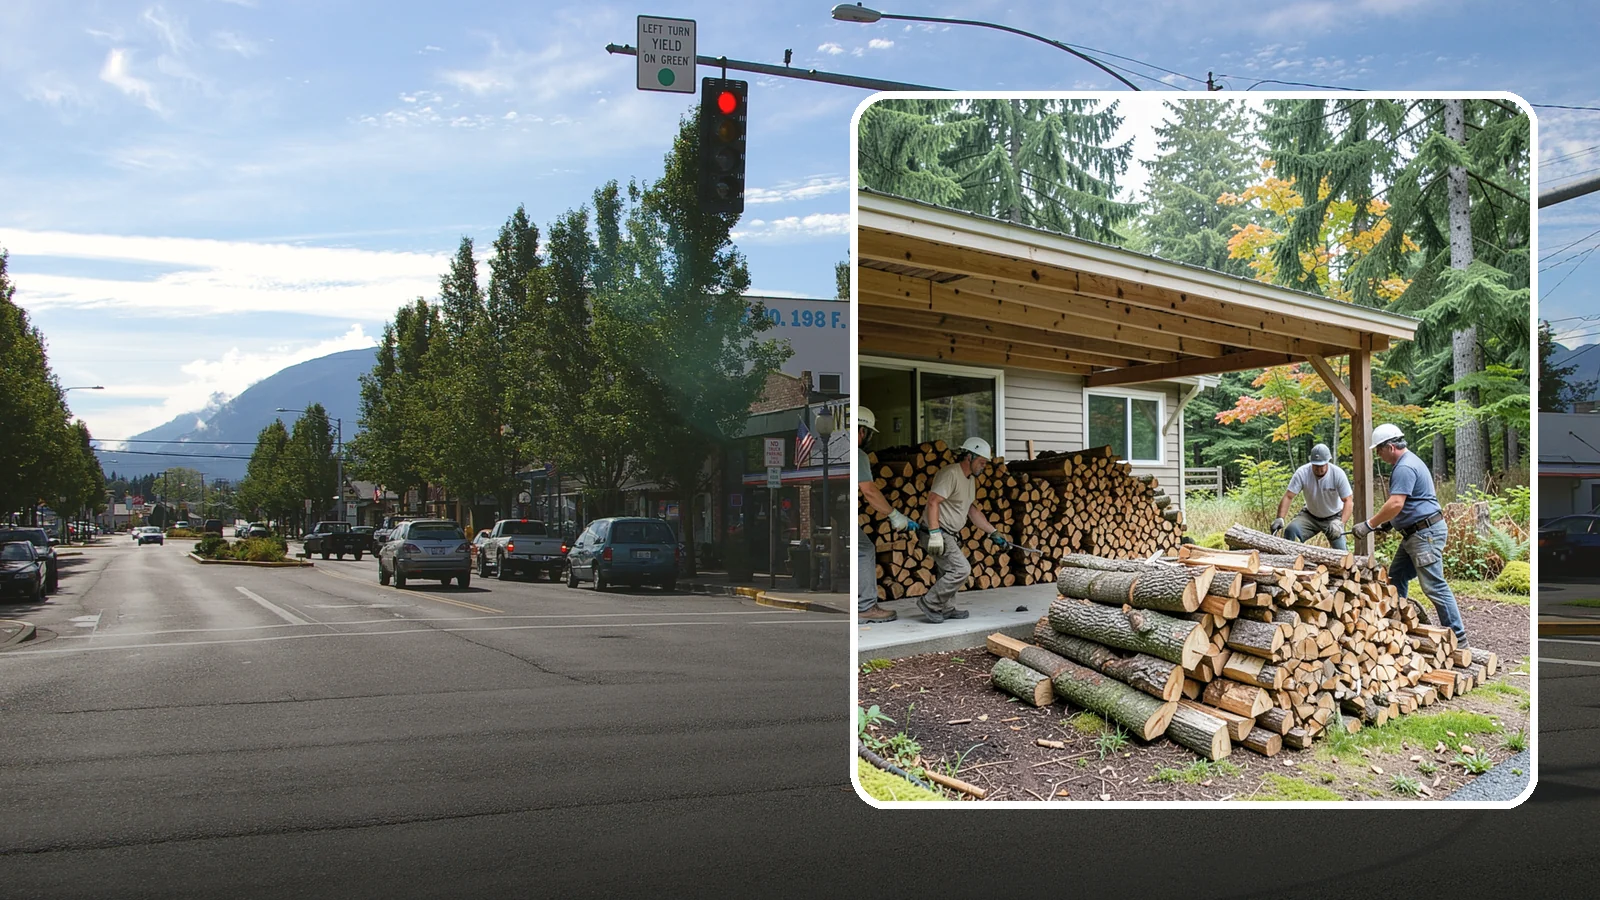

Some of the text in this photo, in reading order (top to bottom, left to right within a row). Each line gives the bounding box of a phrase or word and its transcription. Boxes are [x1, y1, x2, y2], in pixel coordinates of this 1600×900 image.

[643, 24, 689, 36] LEFT TURN
[652, 38, 681, 51] YIELD
[791, 309, 826, 328] 198
[831, 311, 846, 329] F.
